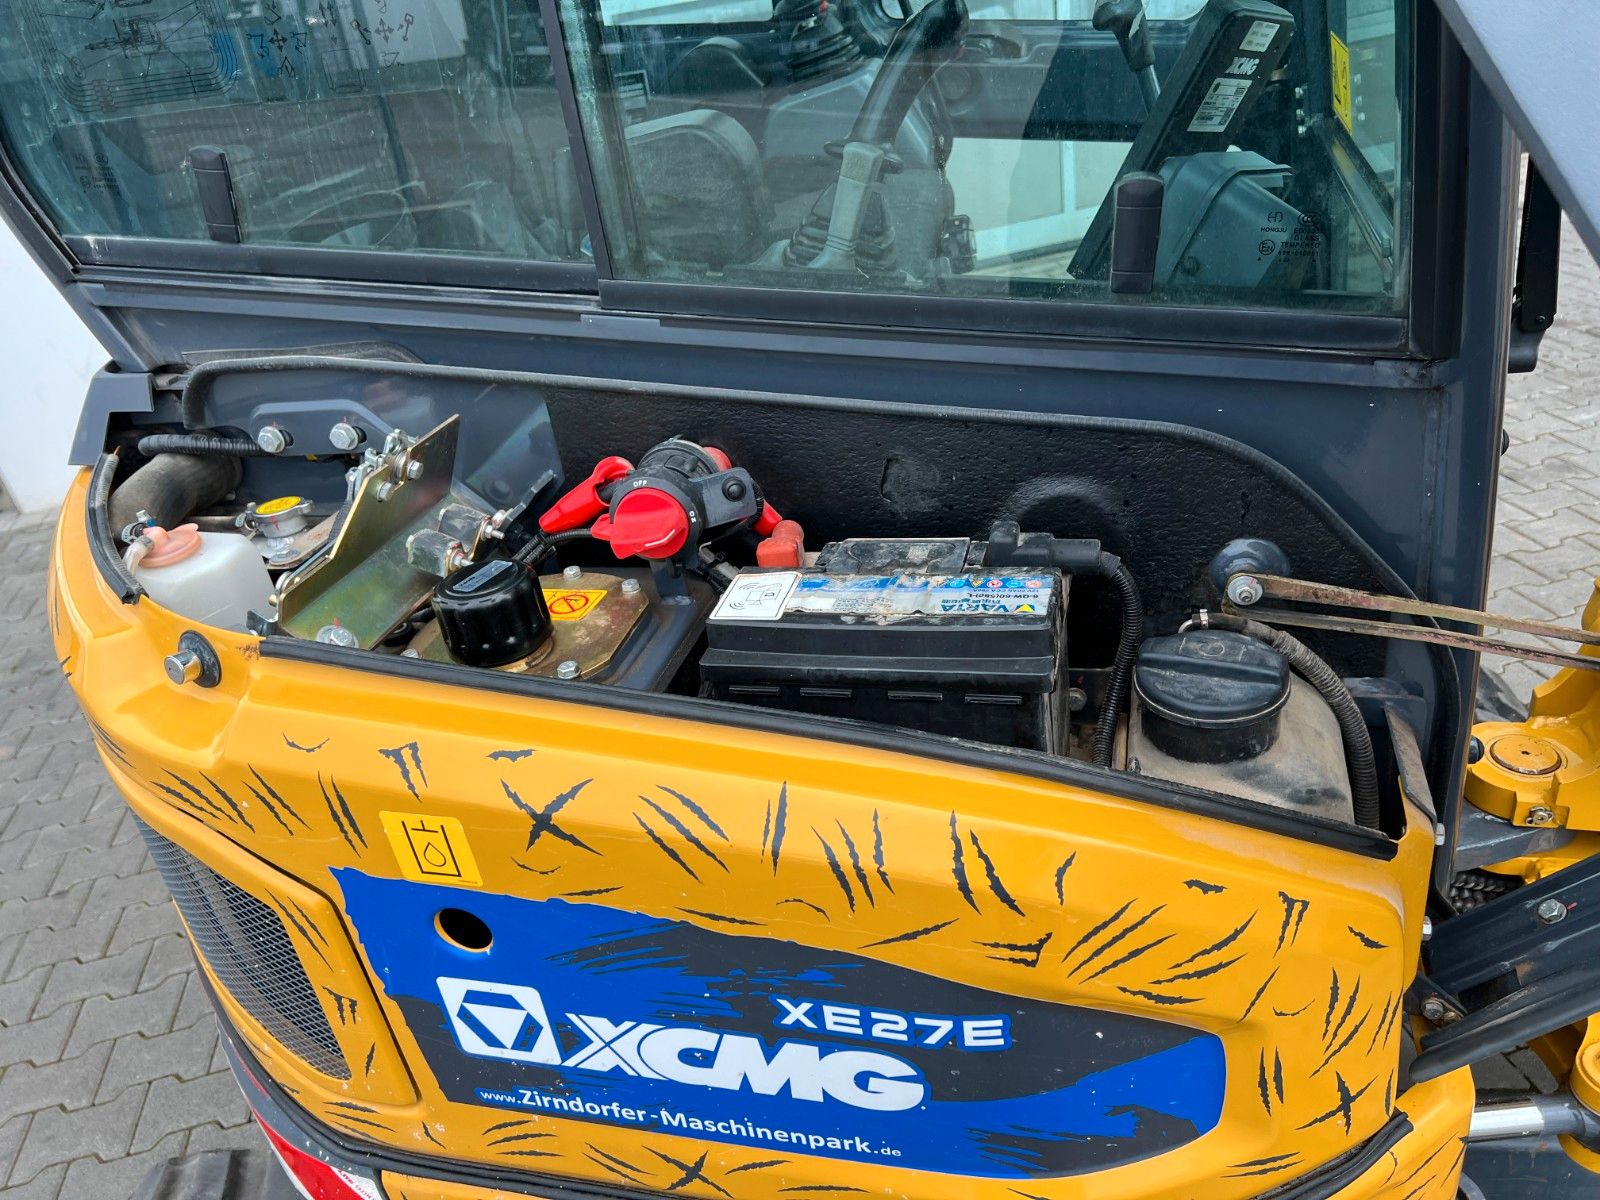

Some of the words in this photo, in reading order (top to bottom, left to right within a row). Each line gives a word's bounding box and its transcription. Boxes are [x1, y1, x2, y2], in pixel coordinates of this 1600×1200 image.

[1224, 56, 1260, 76] XCMG
[633, 479, 648, 487] OFF
[689, 510, 697, 523] ON
[940, 604, 1009, 612] VARTA
[779, 997, 1007, 1048] XE27E
[560, 1012, 925, 1111] XCMG
